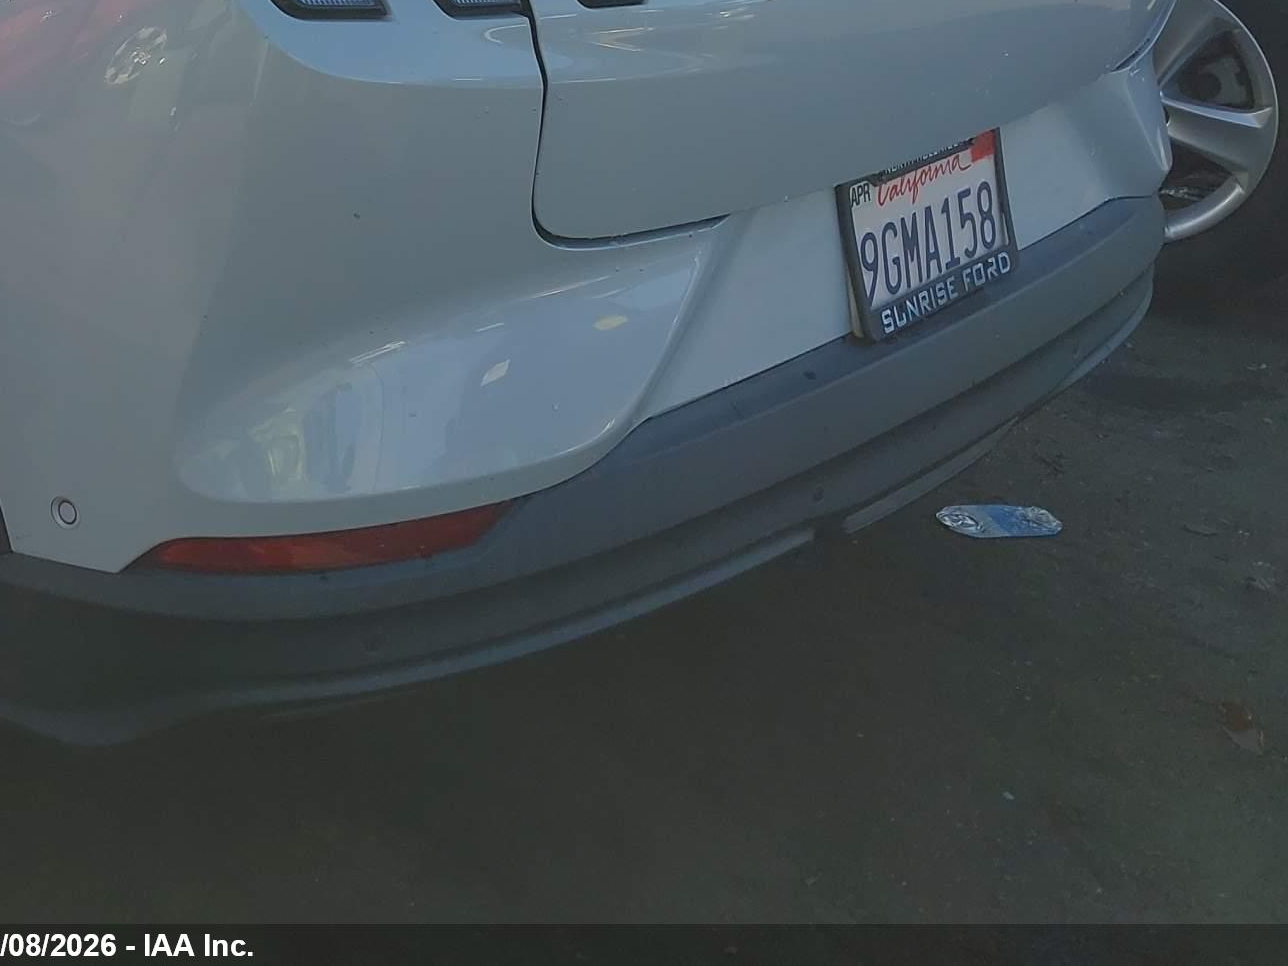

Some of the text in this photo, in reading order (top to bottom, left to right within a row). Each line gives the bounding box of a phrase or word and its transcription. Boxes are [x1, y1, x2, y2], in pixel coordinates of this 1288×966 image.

[850, 183, 871, 207] APR
[877, 153, 971, 207] California
[861, 181, 997, 306] 9GMA158
[962, 251, 1011, 293] FORD
